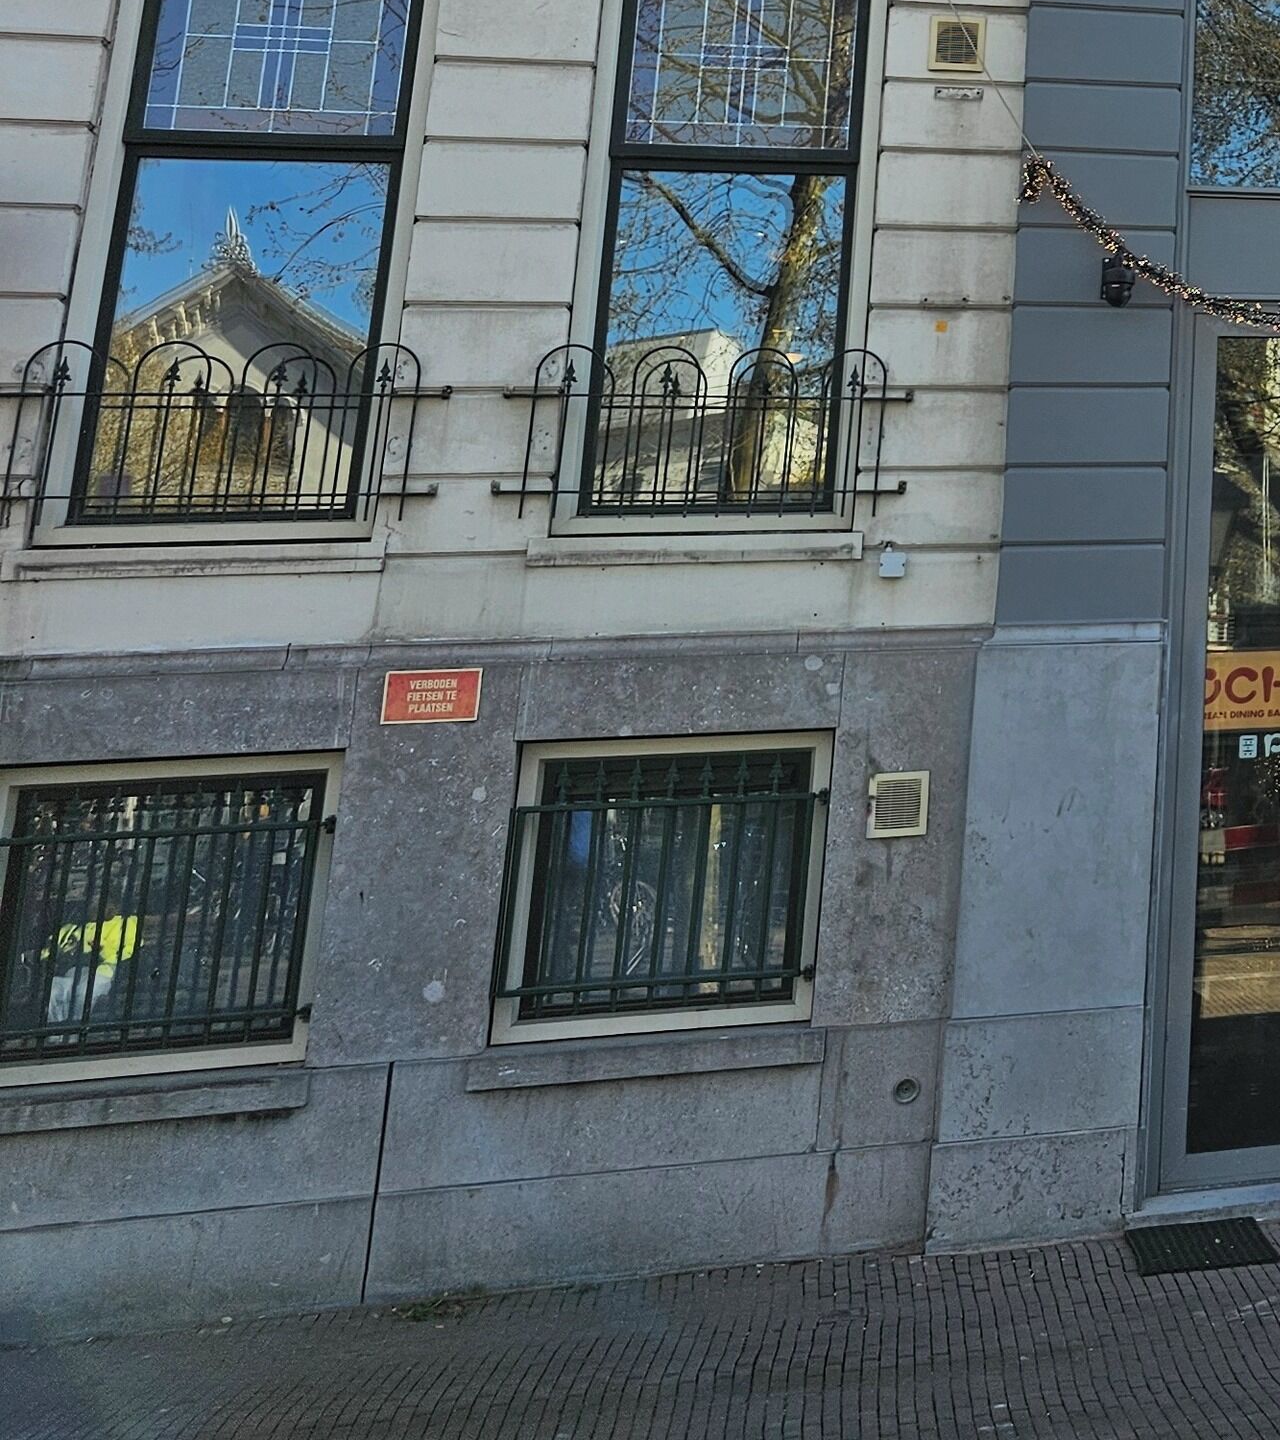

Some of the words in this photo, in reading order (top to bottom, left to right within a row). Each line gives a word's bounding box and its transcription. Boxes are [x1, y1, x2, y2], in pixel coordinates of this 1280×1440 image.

[409, 679, 458, 690] VERBODEN
[407, 691, 444, 702] FIETSEN
[446, 690, 457, 700] TE
[408, 703, 453, 713] PLAATSEN
[1230, 709, 1265, 719] DINING
